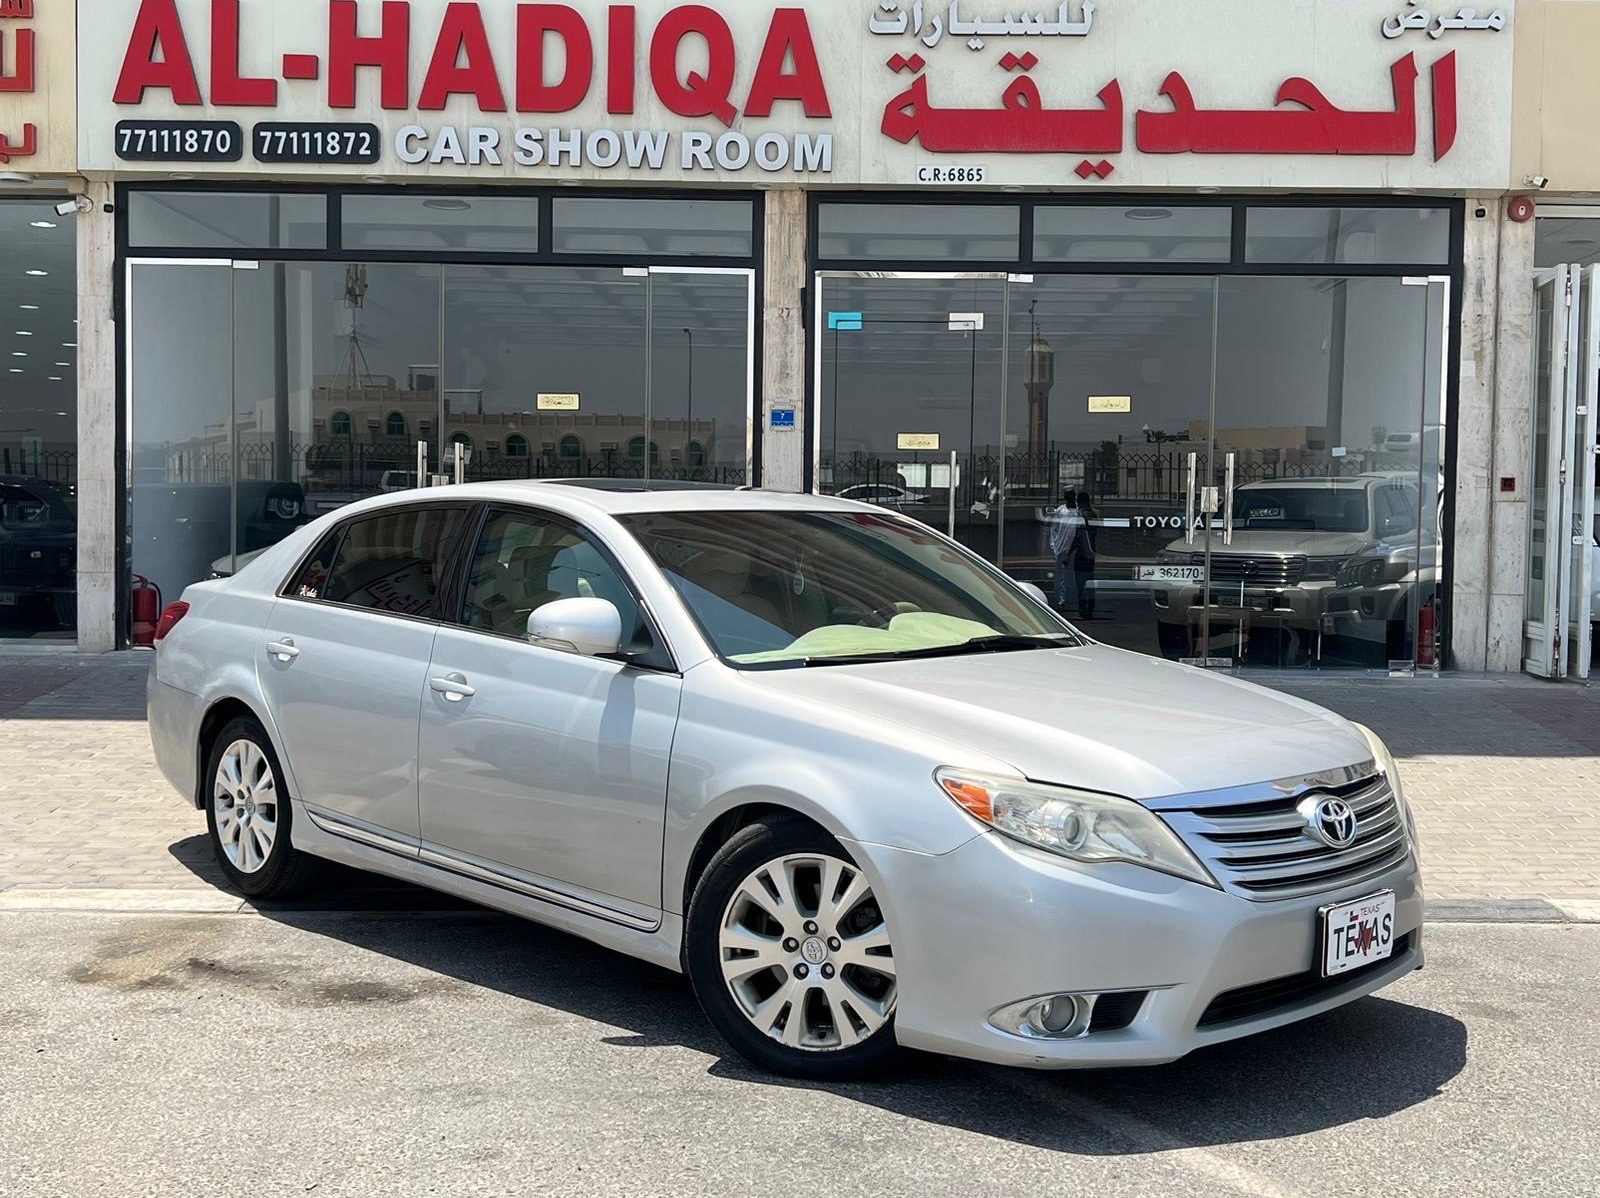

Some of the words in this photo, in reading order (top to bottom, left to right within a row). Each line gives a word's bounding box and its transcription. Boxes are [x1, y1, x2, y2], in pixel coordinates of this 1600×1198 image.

[868, 0, 1095, 50] للسيارات
[1381, 0, 1505, 40] معرض
[112, 0, 833, 128] AL-HADIQA
[880, 50, 1457, 180] الحديقة
[119, 129, 231, 153] 77111870
[259, 131, 371, 155] 77111872
[395, 125, 502, 165] CAR
[513, 127, 669, 169] SHOW
[682, 131, 833, 173] ROOM
[918, 167, 983, 182] C.R:6865
[1134, 516, 1204, 528] TOYOA
[1160, 567, 1199, 579] 362170
[1361, 904, 1380, 916] TEXAS
[1333, 913, 1391, 960] TEXAS
